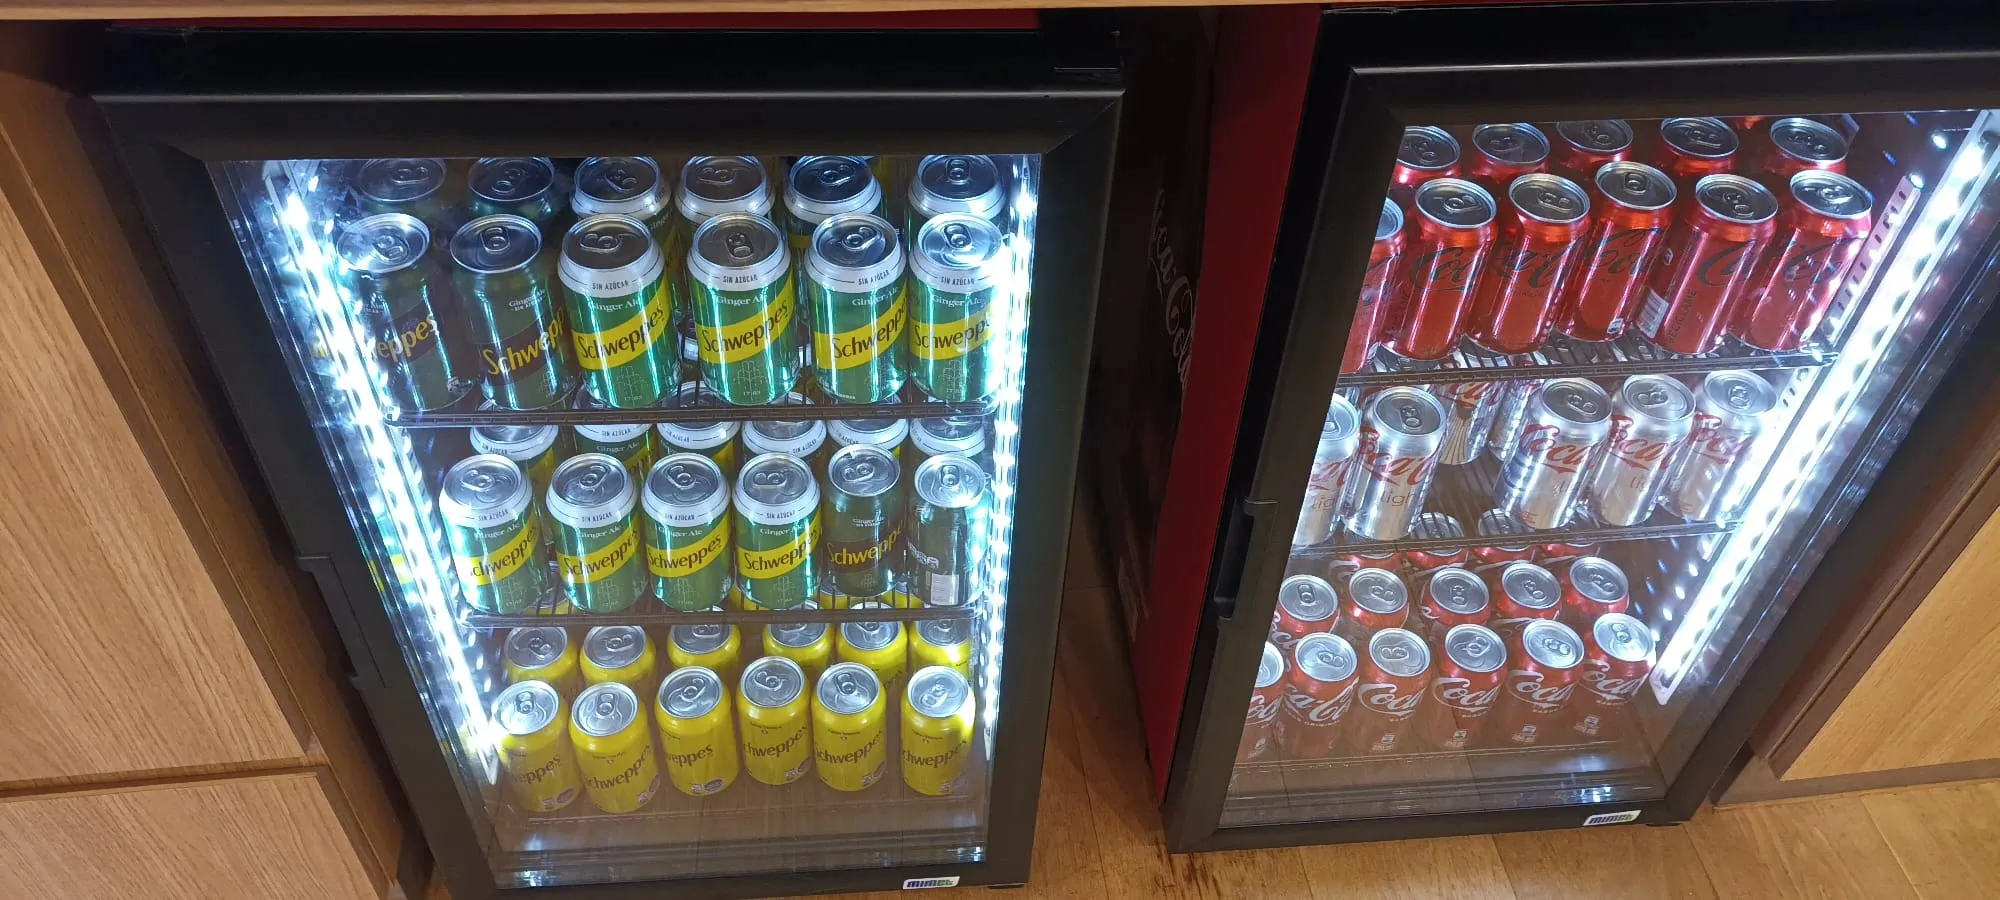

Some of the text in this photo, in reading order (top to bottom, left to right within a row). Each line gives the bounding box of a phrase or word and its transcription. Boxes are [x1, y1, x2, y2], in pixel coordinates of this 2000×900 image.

[702, 299, 788, 352] Schweppes
[717, 295, 750, 307] Ginger
[482, 307, 565, 376] Schwepp
[577, 307, 665, 359] Schweppes
[648, 534, 722, 568] Schweppes
